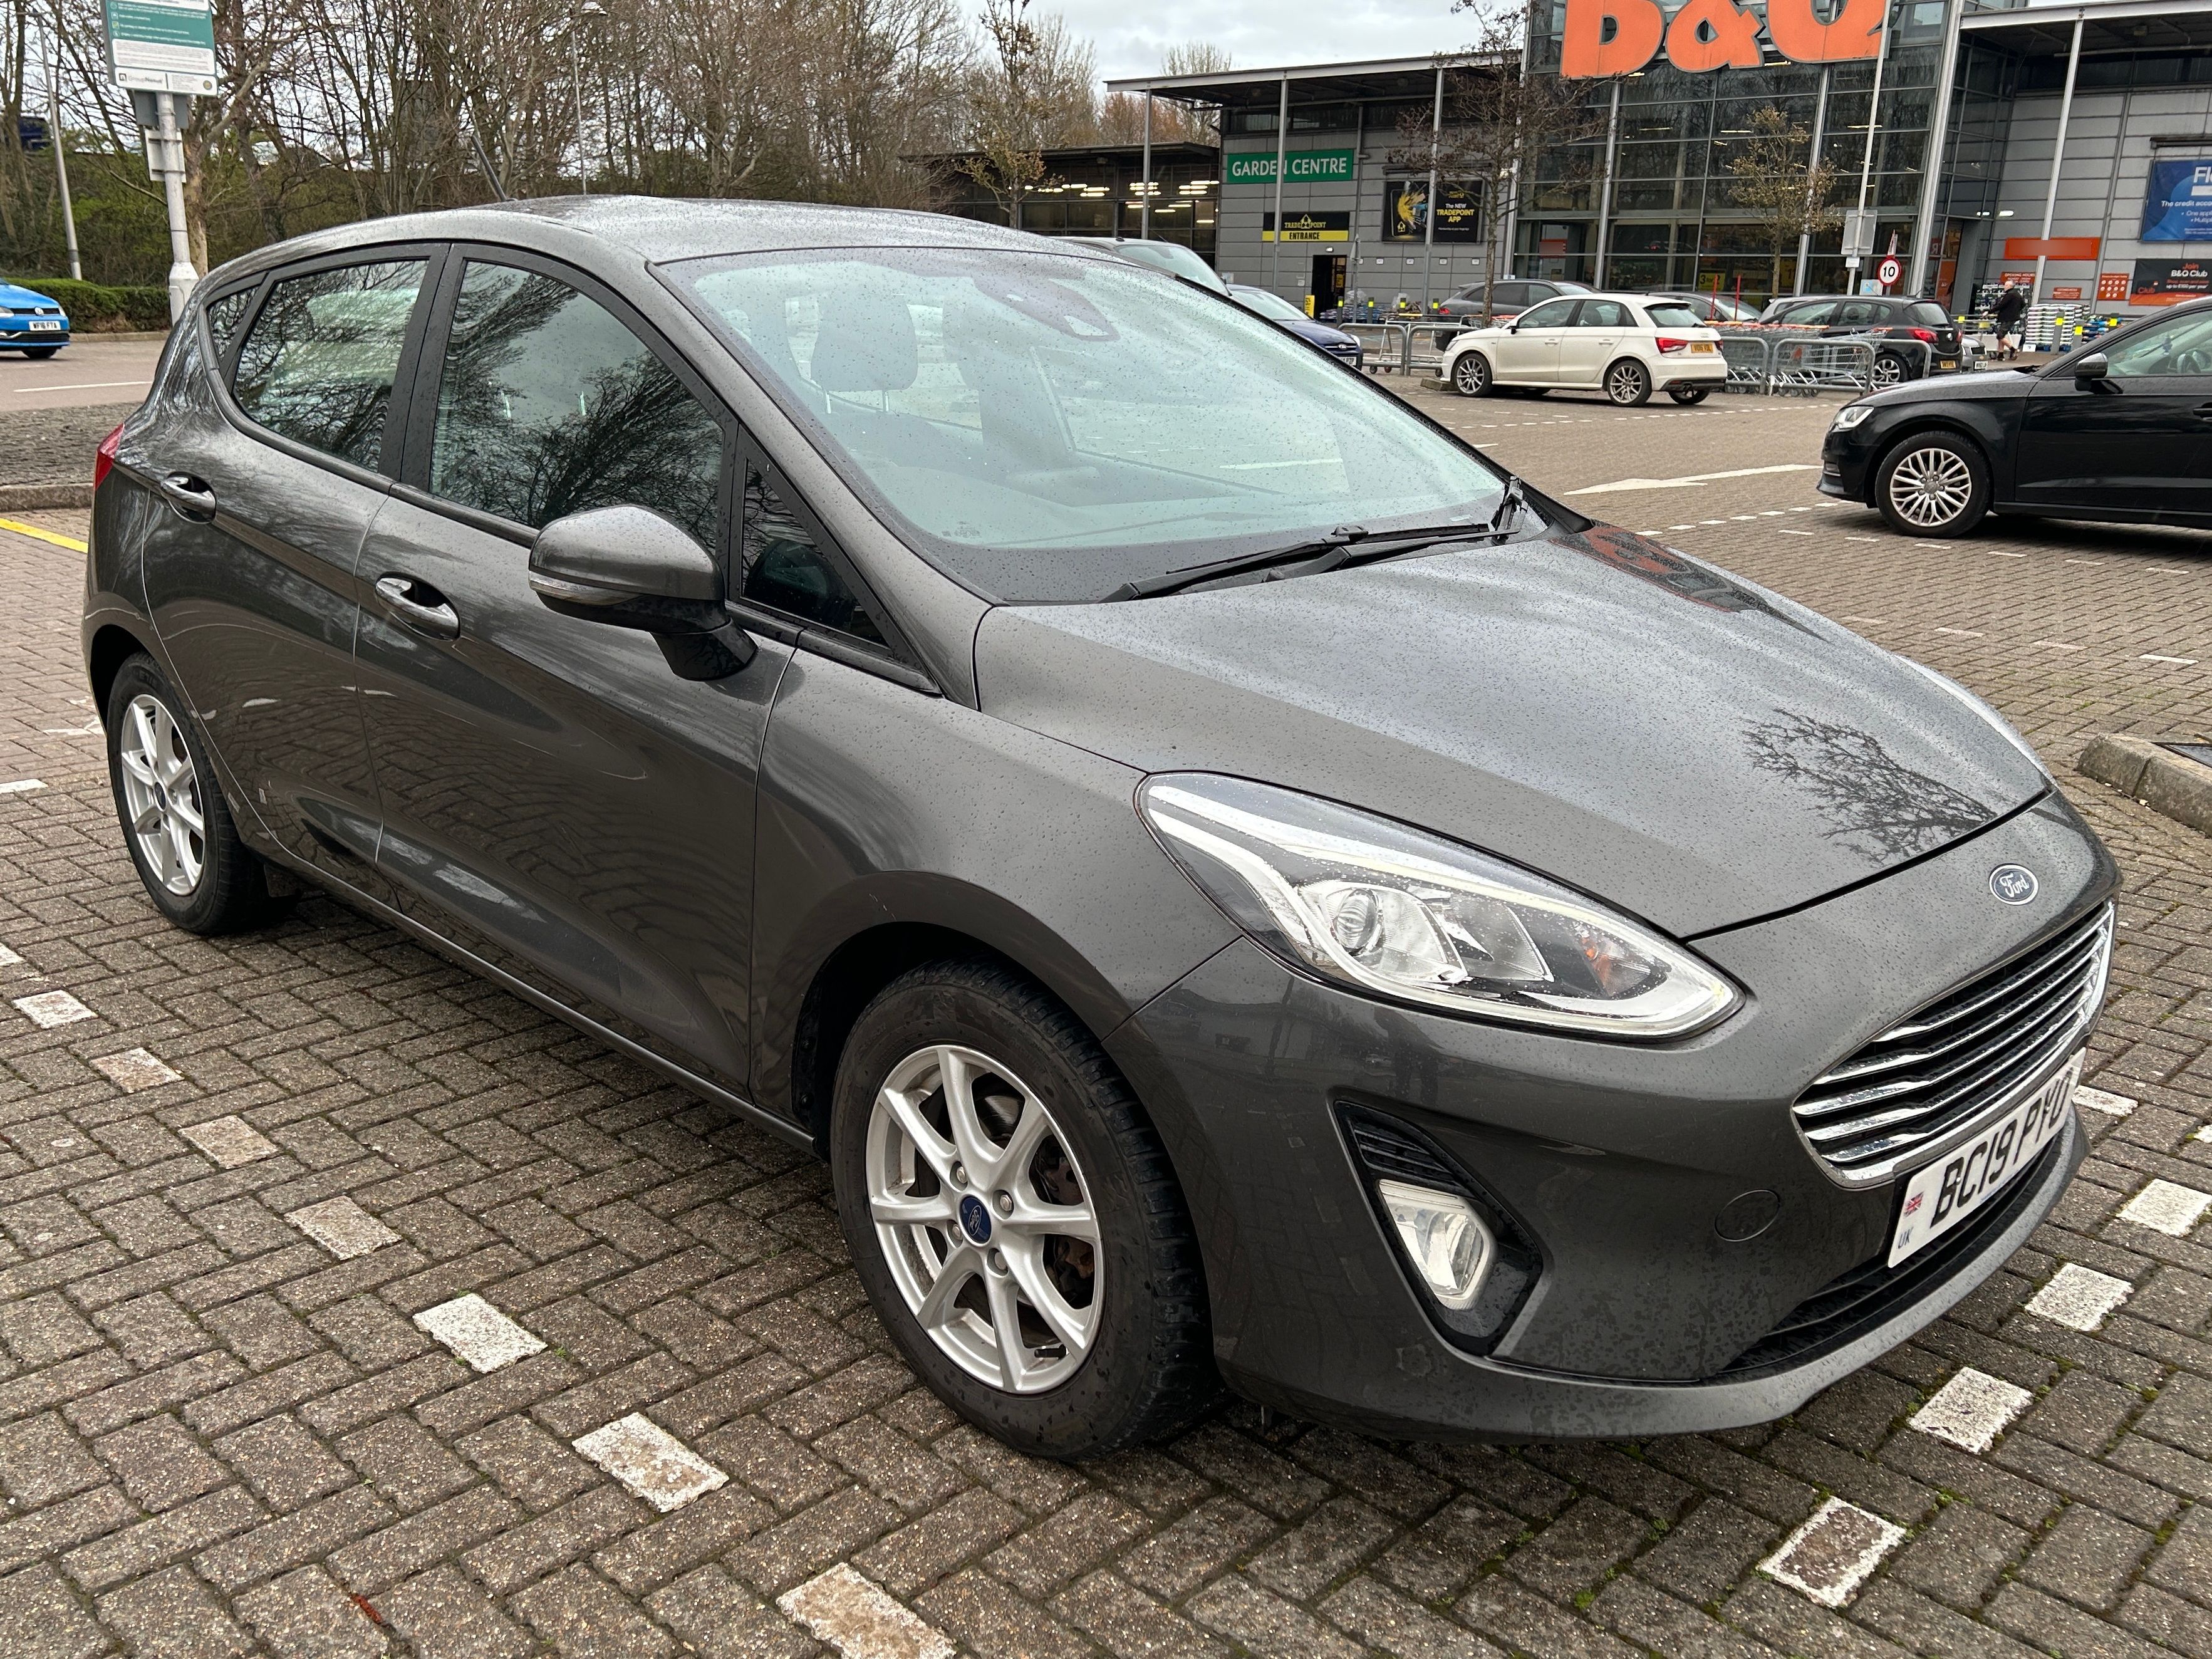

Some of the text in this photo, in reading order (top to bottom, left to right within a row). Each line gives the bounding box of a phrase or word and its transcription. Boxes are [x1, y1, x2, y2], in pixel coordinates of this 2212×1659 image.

[1292, 157, 1347, 174] CENTRE
[2193, 166, 2212, 183] Fl
[1289, 232, 1320, 240] ENTRANCE
[1700, 274, 1706, 284] 3
[1883, 266, 1895, 277] 10
[2000, 873, 2030, 897] Ford
[1930, 1119, 2018, 1229] BC19
[1898, 1226, 1914, 1249] UK
